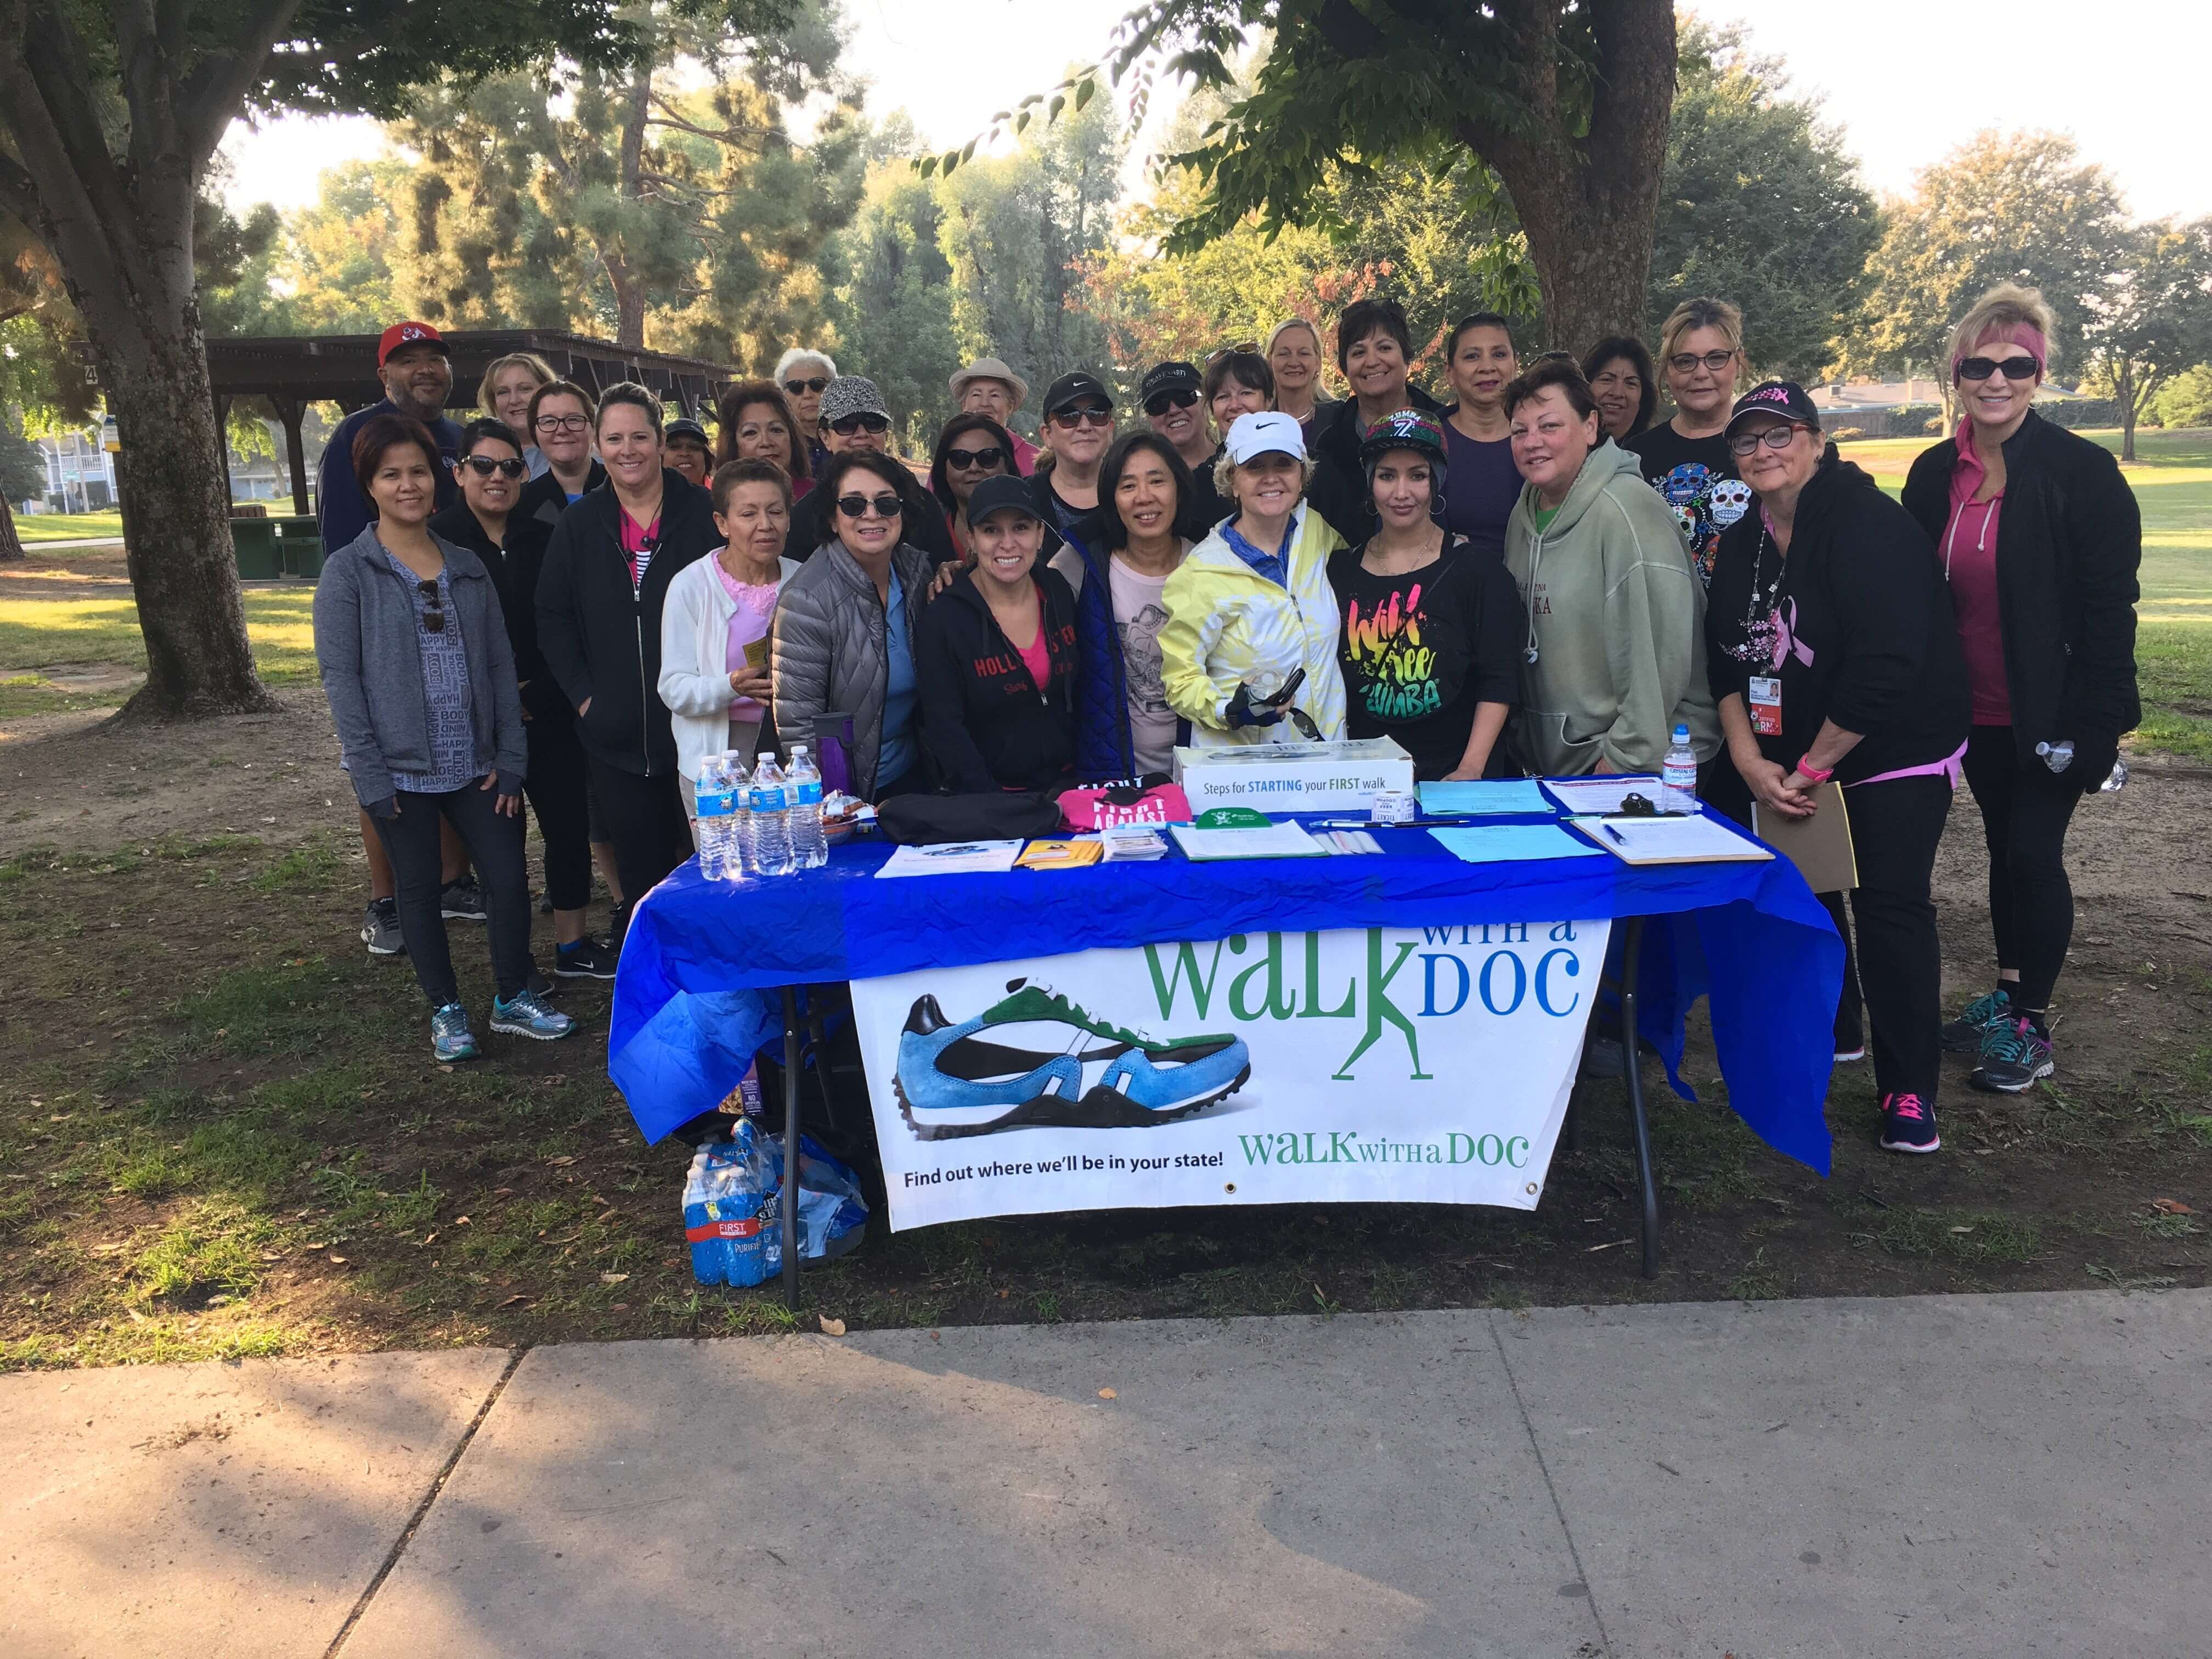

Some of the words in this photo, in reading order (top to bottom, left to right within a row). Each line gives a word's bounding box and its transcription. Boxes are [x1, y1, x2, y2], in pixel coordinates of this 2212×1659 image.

[86, 368, 97, 382] 4
[1389, 410, 1421, 422] ZUMBA
[444, 610, 457, 645] SOUL
[428, 654, 441, 684] BODY
[448, 653, 457, 675] SOUL
[456, 653, 468, 685] BODY
[974, 653, 1020, 677] HOLL
[427, 693, 460, 704] HAPPY
[441, 710, 470, 720] BODY
[1760, 721, 1773, 732] RN
[430, 749, 449, 758] MIN
[442, 740, 469, 748] HAPPY
[454, 752, 465, 782] SOUL
[422, 777, 453, 786] HAPPY
[1204, 783, 1230, 796] Steps
[1233, 781, 1246, 793] for
[1248, 779, 1302, 793] STARTING
[1305, 780, 1327, 793] your
[1329, 778, 1360, 790] FIRST
[1362, 777, 1386, 789] walk
[1093, 811, 1166, 830] AGAINST
[1417, 947, 1580, 1017] DOC
[1426, 1143, 1443, 1164] a
[1446, 1132, 1530, 1168] DOC
[904, 1169, 941, 1187] Find
[945, 1166, 973, 1182] out
[977, 1160, 1032, 1178] where
[1082, 1155, 1104, 1170] be
[1109, 1154, 1126, 1170] in
[1130, 1156, 1170, 1173] your
[1174, 1152, 1224, 1168] state!
[734, 1240, 762, 1254] PURIFIE
